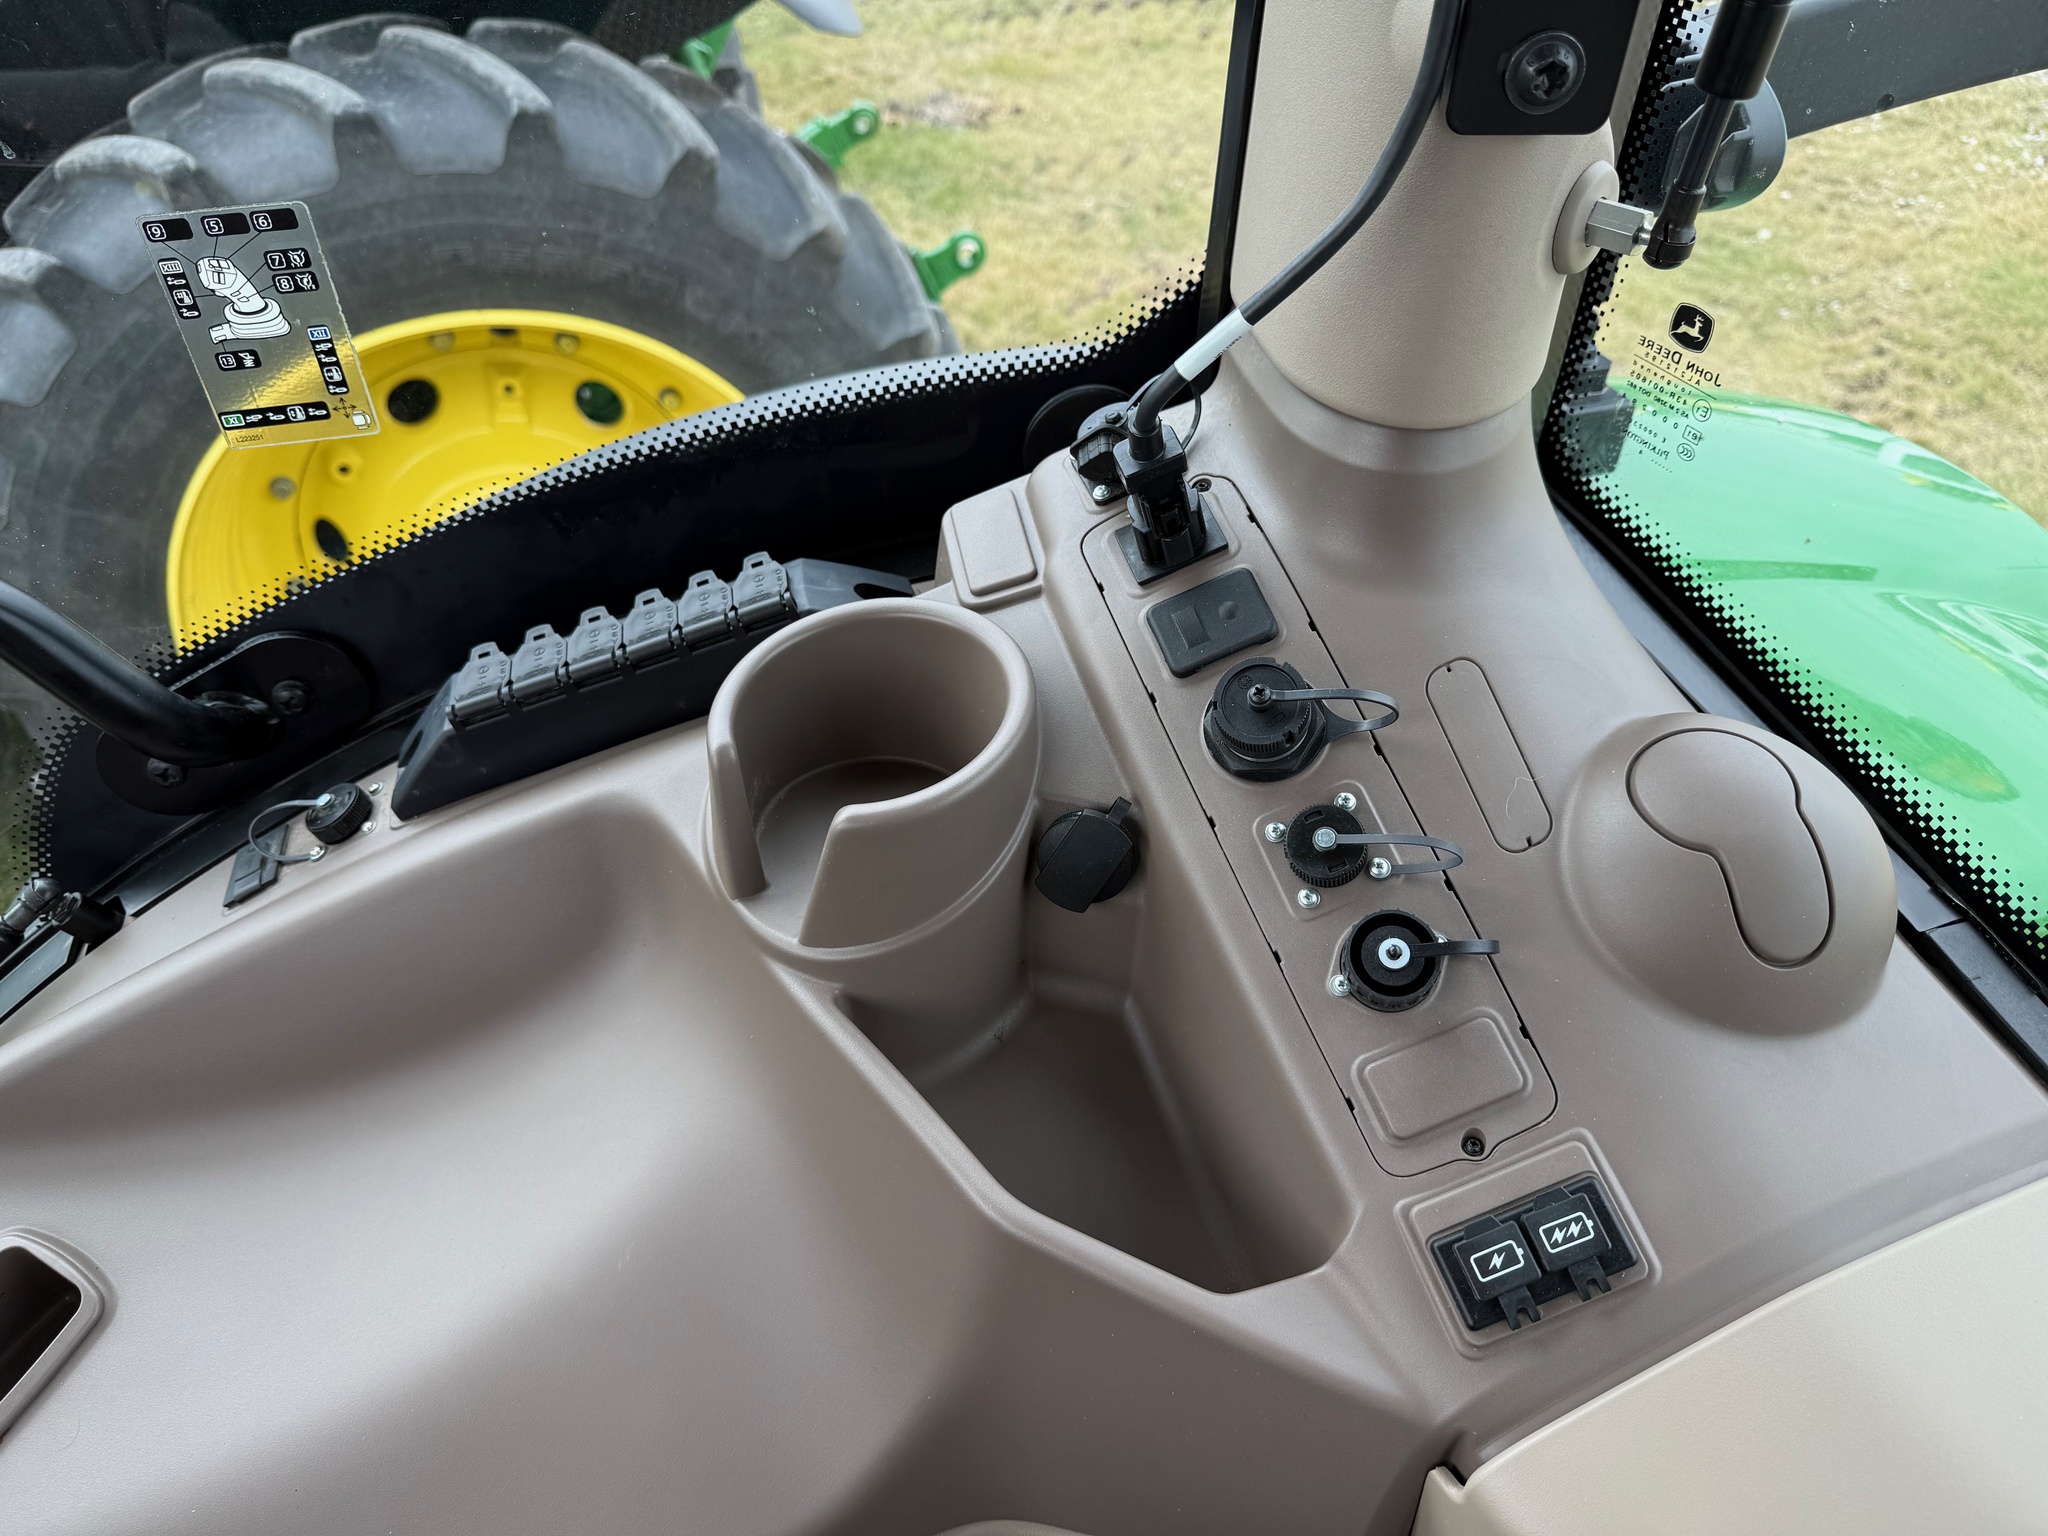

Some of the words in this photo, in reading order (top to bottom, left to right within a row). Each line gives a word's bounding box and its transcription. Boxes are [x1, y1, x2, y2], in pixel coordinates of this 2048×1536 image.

[210, 220, 219, 232] 5
[258, 215, 268, 228] 6
[152, 226, 161, 238] 9
[271, 255, 279, 266] 7
[162, 262, 180, 273] XIII
[280, 278, 290, 289] 8
[312, 329, 327, 339] XII
[221, 357, 234, 366] 13
[235, 434, 265, 443] L223251
